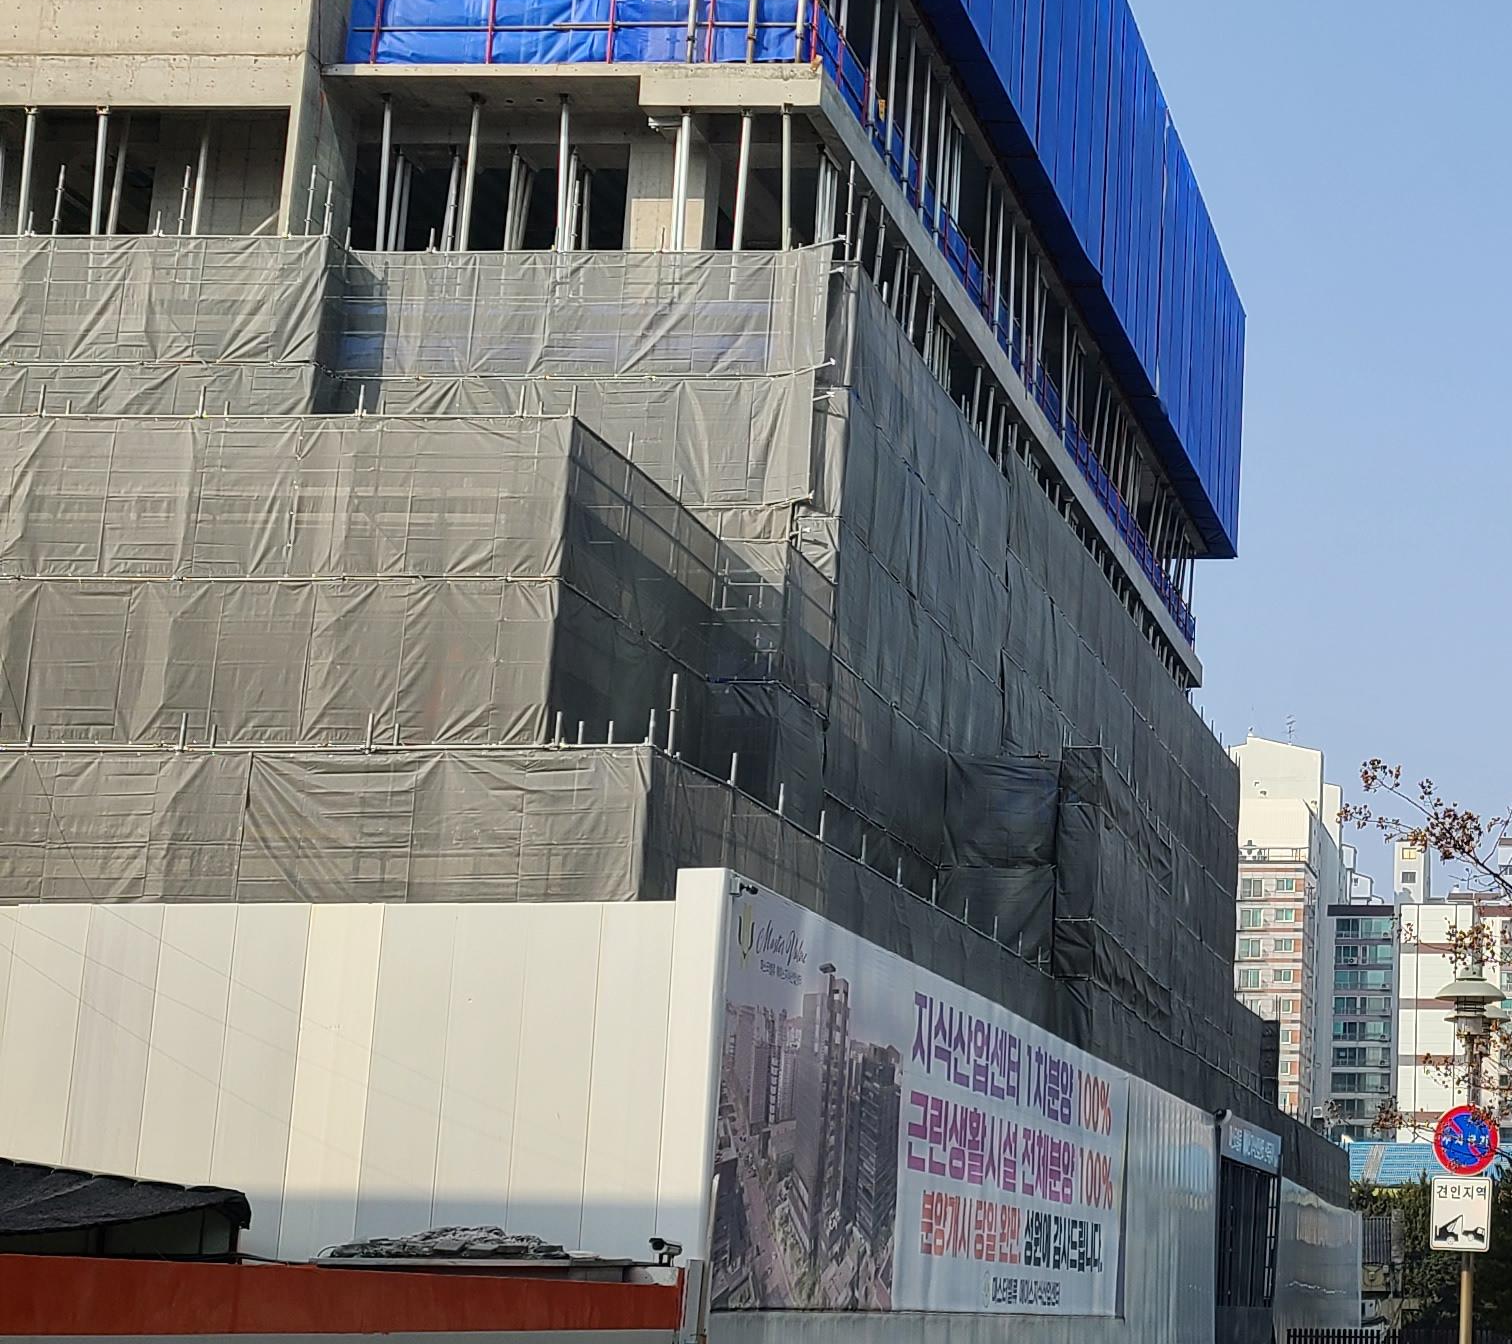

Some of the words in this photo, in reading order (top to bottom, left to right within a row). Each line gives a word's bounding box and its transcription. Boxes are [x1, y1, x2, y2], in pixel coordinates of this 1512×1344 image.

[912, 991, 1021, 1106] 지식산업센터
[1027, 1044, 1074, 1126] 1차분양
[1077, 1069, 1111, 1136] 100%
[907, 1090, 1018, 1193] 근린생활시설
[1021, 1127, 1076, 1205] 전체분양
[1079, 1147, 1114, 1210] 100%
[1436, 1184, 1487, 1200] 견인지역
[920, 1190, 973, 1259] 분양개시
[974, 1199, 997, 1263] 당일
[1024, 1209, 1052, 1269] 성원에
